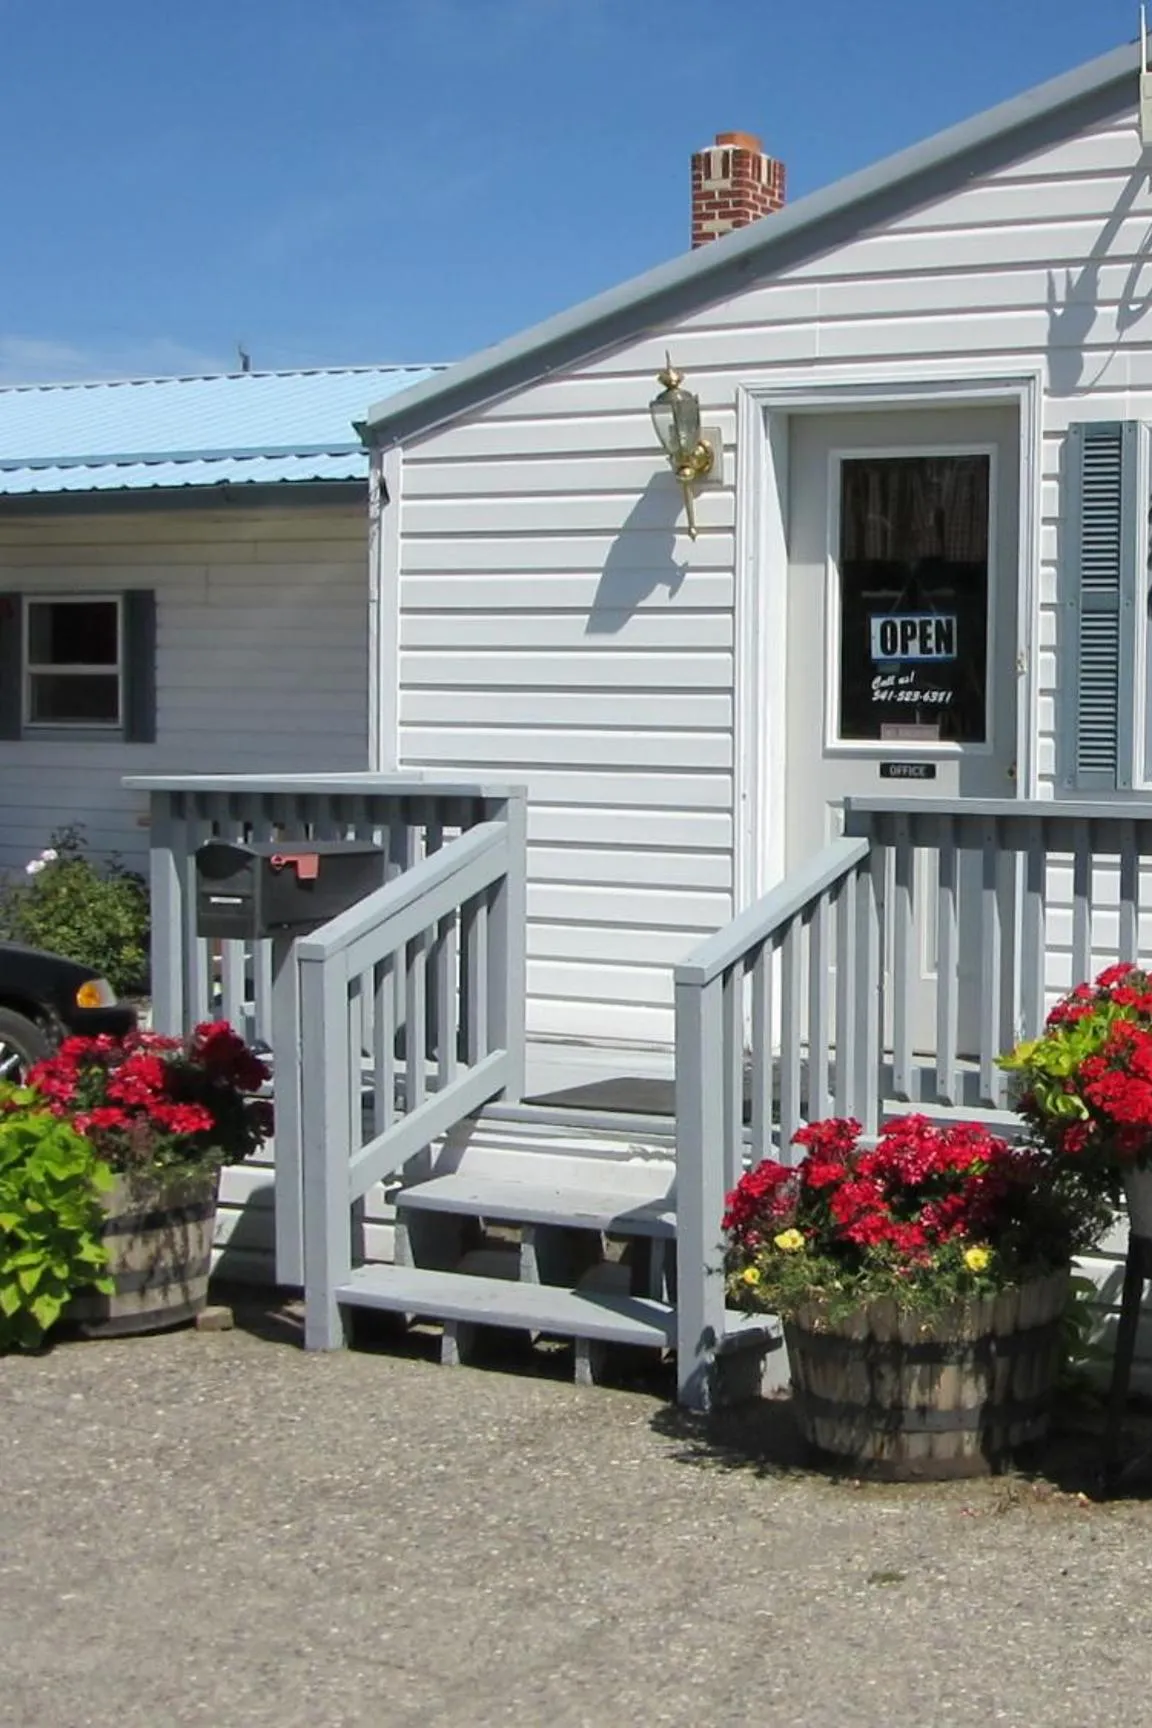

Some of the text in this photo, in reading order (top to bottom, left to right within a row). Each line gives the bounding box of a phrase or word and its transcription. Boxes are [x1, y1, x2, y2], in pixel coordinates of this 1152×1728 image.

[880, 619, 953, 656] OPEN
[872, 675, 896, 690] Call
[889, 765, 926, 777] OFFICE
